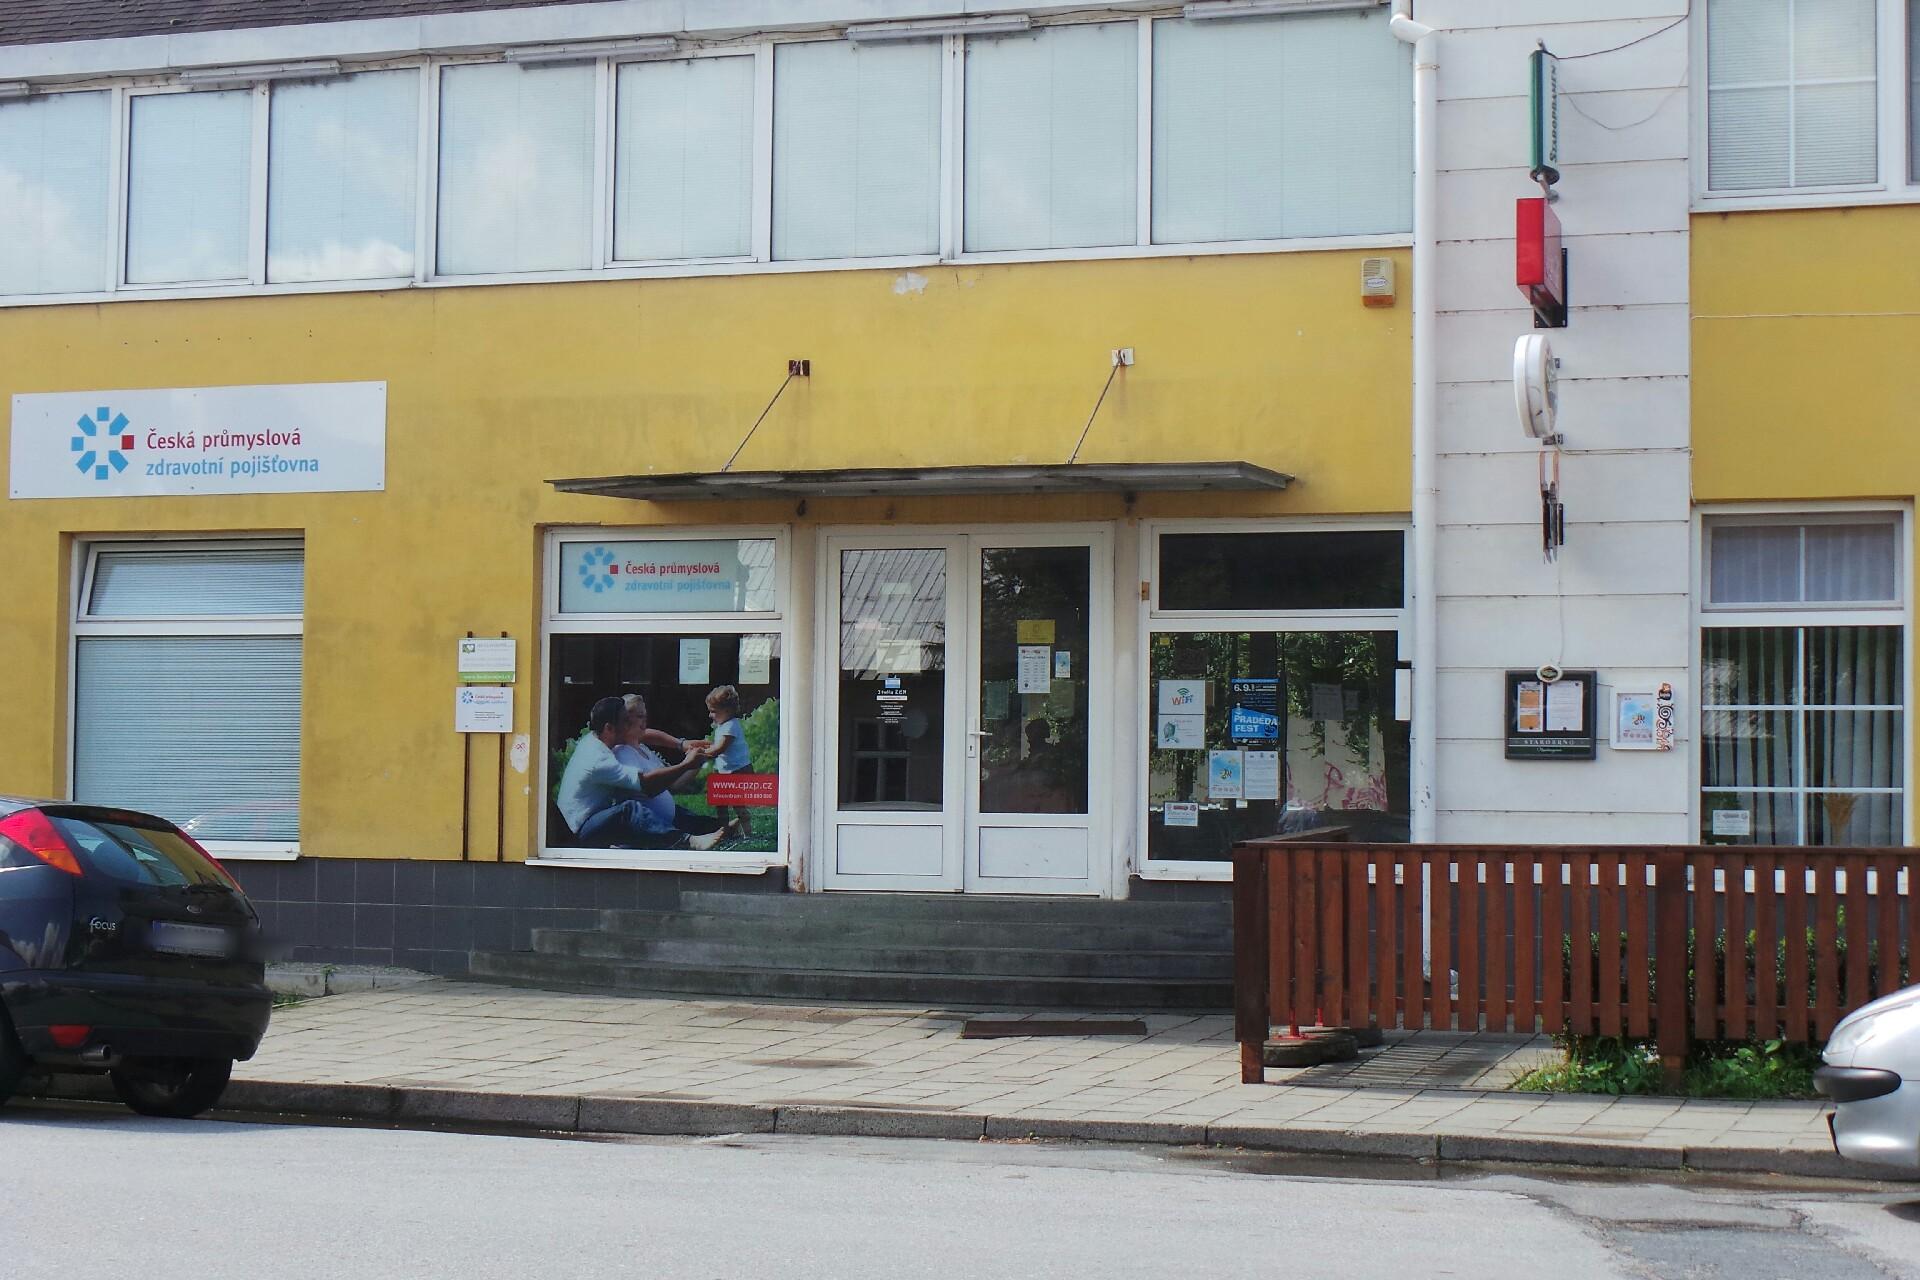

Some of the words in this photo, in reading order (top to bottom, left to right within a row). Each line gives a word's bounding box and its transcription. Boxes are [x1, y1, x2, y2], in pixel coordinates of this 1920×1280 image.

[146, 428, 196, 450] Česká
[202, 427, 302, 453] průmyslová
[145, 456, 224, 476] zdravotní
[230, 454, 320, 479] pojišťovna
[625, 560, 656, 575] Česká
[659, 560, 721, 577] průmyslová
[624, 579, 673, 592] zdravotní
[1234, 724, 1260, 733] FEST
[712, 781, 774, 791] www.cpzp.cz
